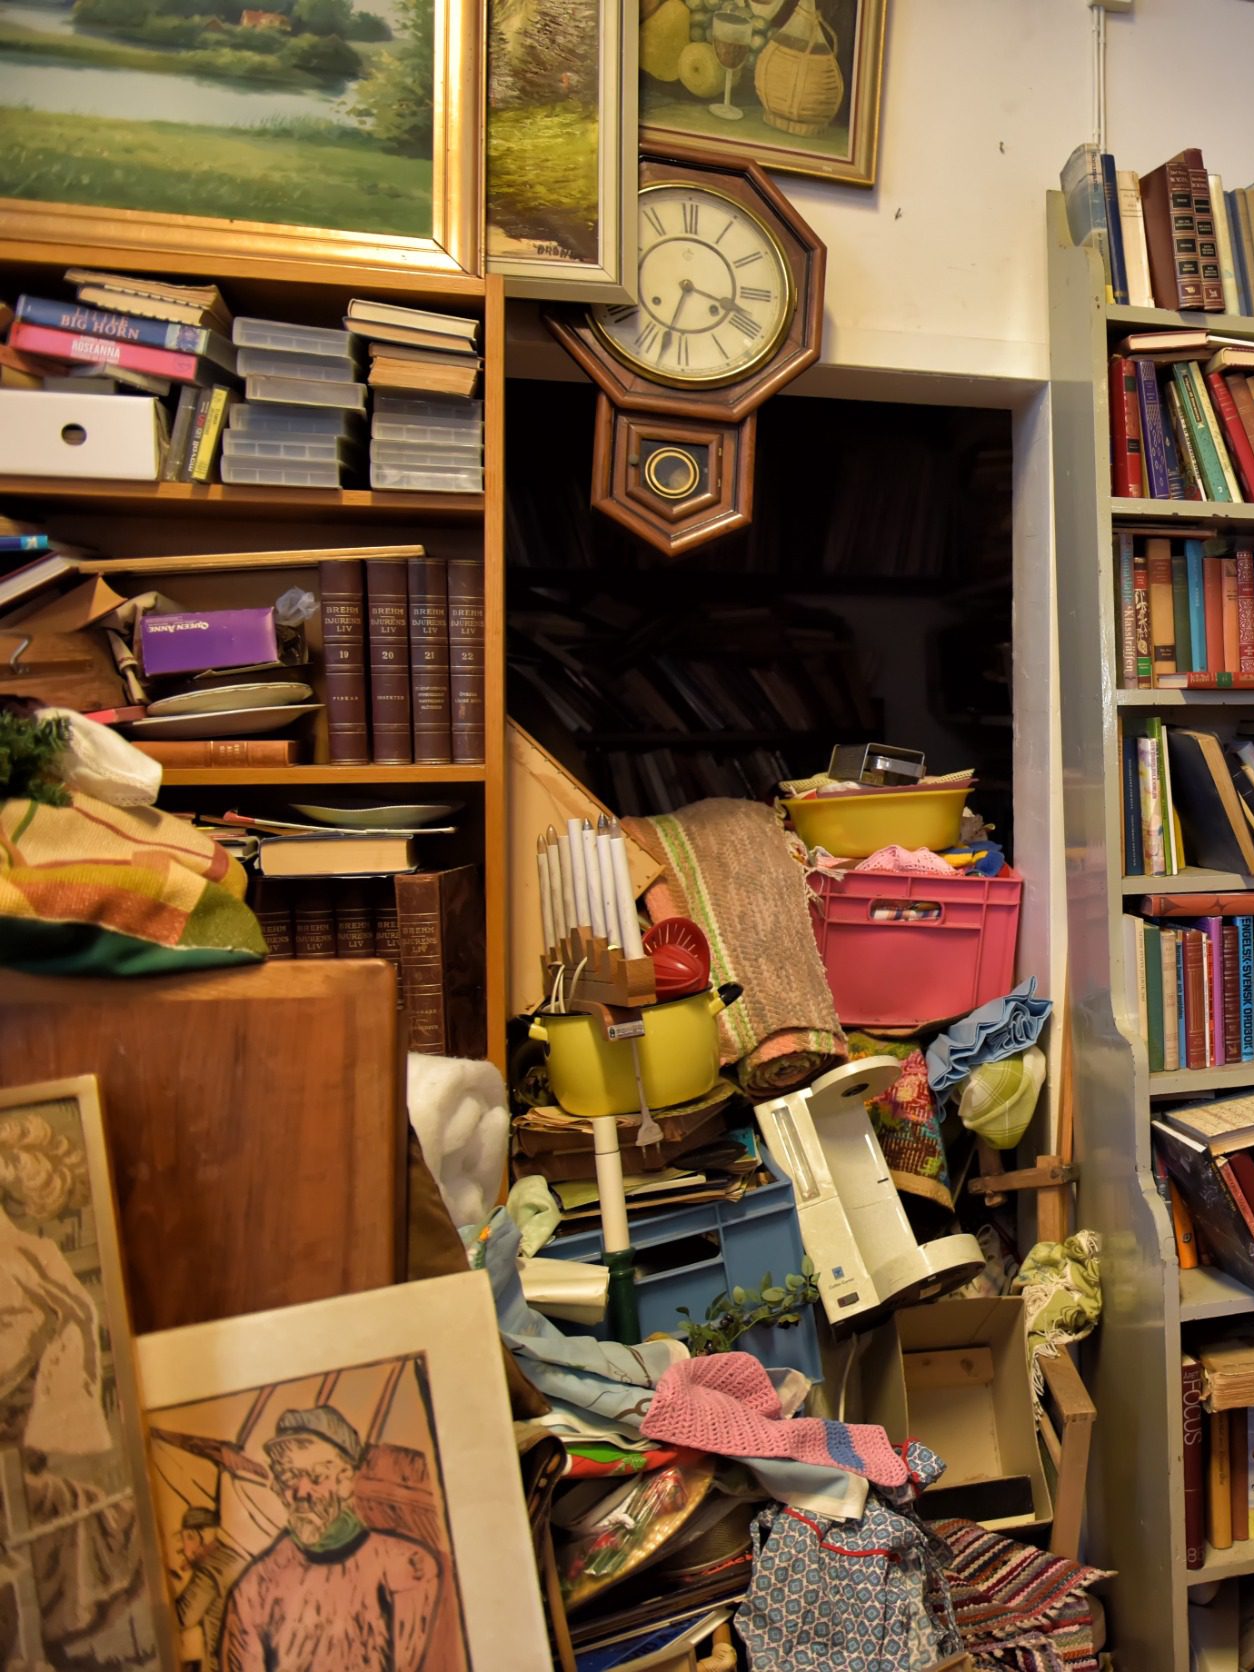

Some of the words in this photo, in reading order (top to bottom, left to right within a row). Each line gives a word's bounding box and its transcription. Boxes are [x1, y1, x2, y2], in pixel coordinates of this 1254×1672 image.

[60, 314, 87, 330] BIG
[92, 321, 140, 341] HORN
[326, 606, 359, 614] BREHM
[372, 607, 404, 615] BREHM
[413, 608, 444, 616] BREHM
[324, 617, 361, 625] DJURENS
[370, 618, 406, 626] DJURENS
[148, 624, 175, 633] ANNE
[176, 621, 209, 631] QUEEN
[1123, 608, 1136, 673] Klassträffen
[339, 651, 349, 659] 19
[382, 651, 394, 660] 20
[424, 651, 435, 660] 21
[461, 652, 474, 660] 22
[264, 925, 287, 933] REHM
[297, 924, 329, 932] BREHM
[339, 922, 369, 930] BREHM
[377, 921, 400, 929] BRE
[296, 935, 332, 943] DJURENS
[348, 940, 364, 948] LIV
[1243, 1007, 1254, 1050] ORDBOK
[1183, 1379, 1202, 1446] FOCUS
